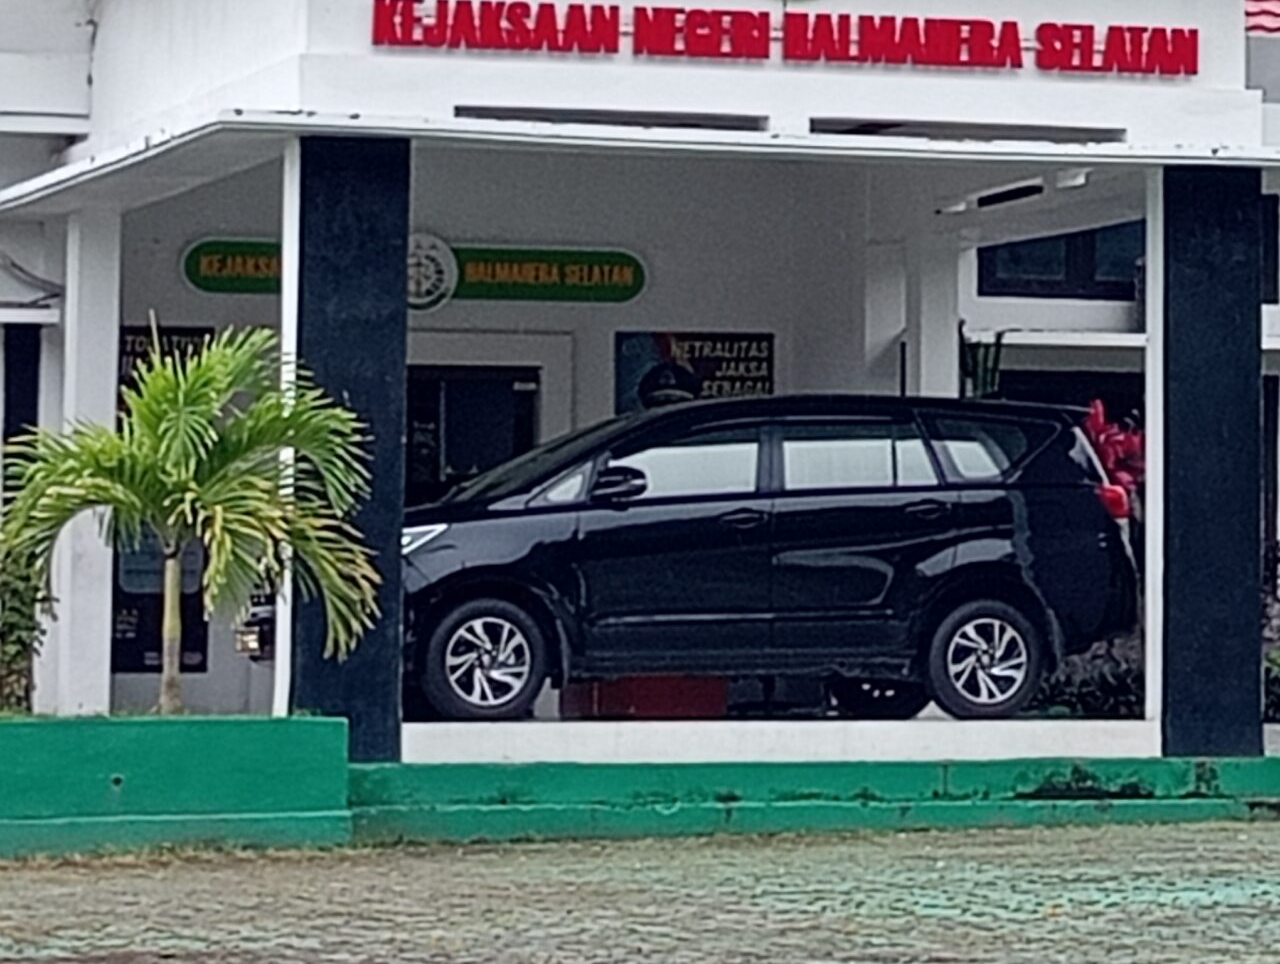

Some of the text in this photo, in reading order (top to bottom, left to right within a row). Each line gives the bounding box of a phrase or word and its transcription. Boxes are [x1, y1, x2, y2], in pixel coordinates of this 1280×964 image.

[632, 7, 771, 59] NEGERI
[781, 11, 1023, 69] HALMAHERA
[1035, 22, 1199, 75] SELATAN
[200, 254, 282, 278] KEJAKSA
[564, 263, 634, 286] SELATAN
[670, 340, 769, 359] NETRALITAS
[715, 361, 768, 377] JAKSA
